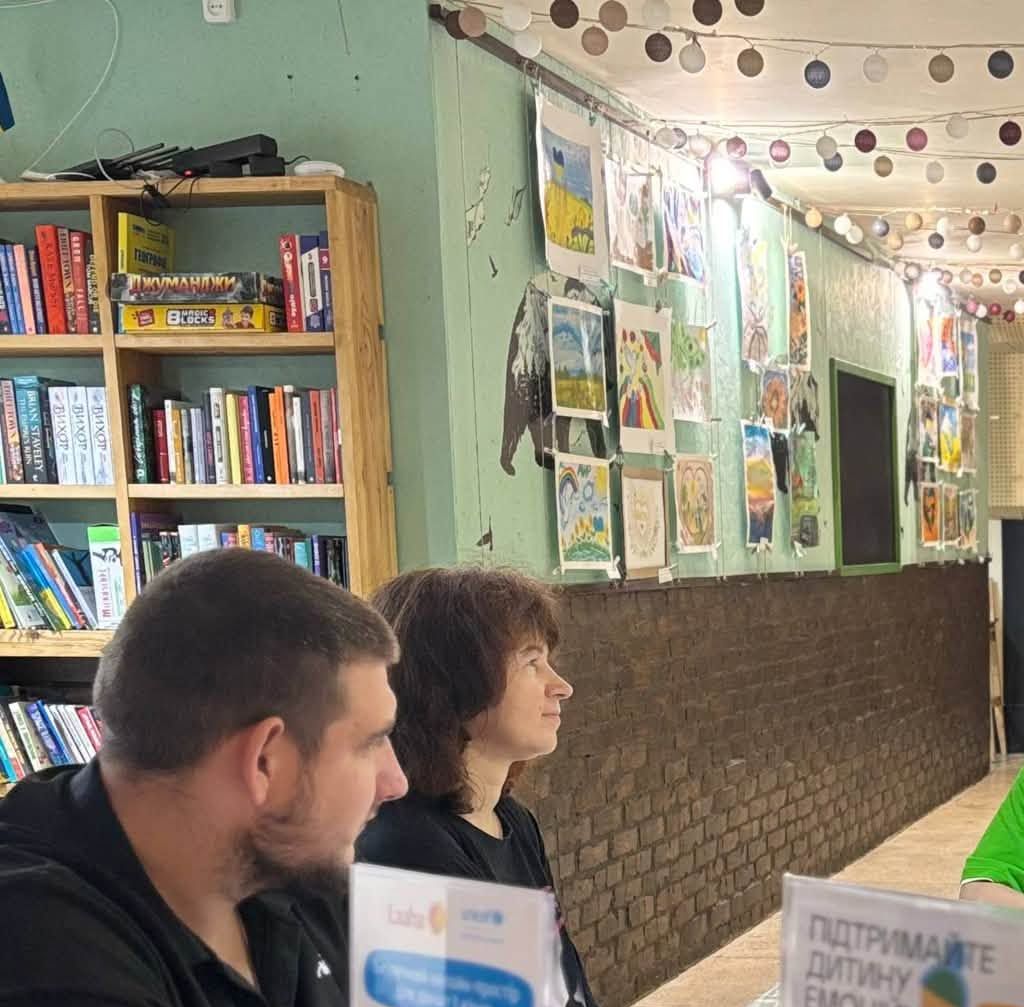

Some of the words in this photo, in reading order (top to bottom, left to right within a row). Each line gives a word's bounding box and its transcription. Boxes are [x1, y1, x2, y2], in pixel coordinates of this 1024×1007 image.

[128, 275, 236, 296] ДЖУМАНДЖИ
[27, 390, 40, 423] BRIAN
[31, 426, 44, 473] STAVELEY
[809, 913, 996, 975] ПІДТРИМАЙТЕ
[805, 950, 913, 995] ДИТИНУ
